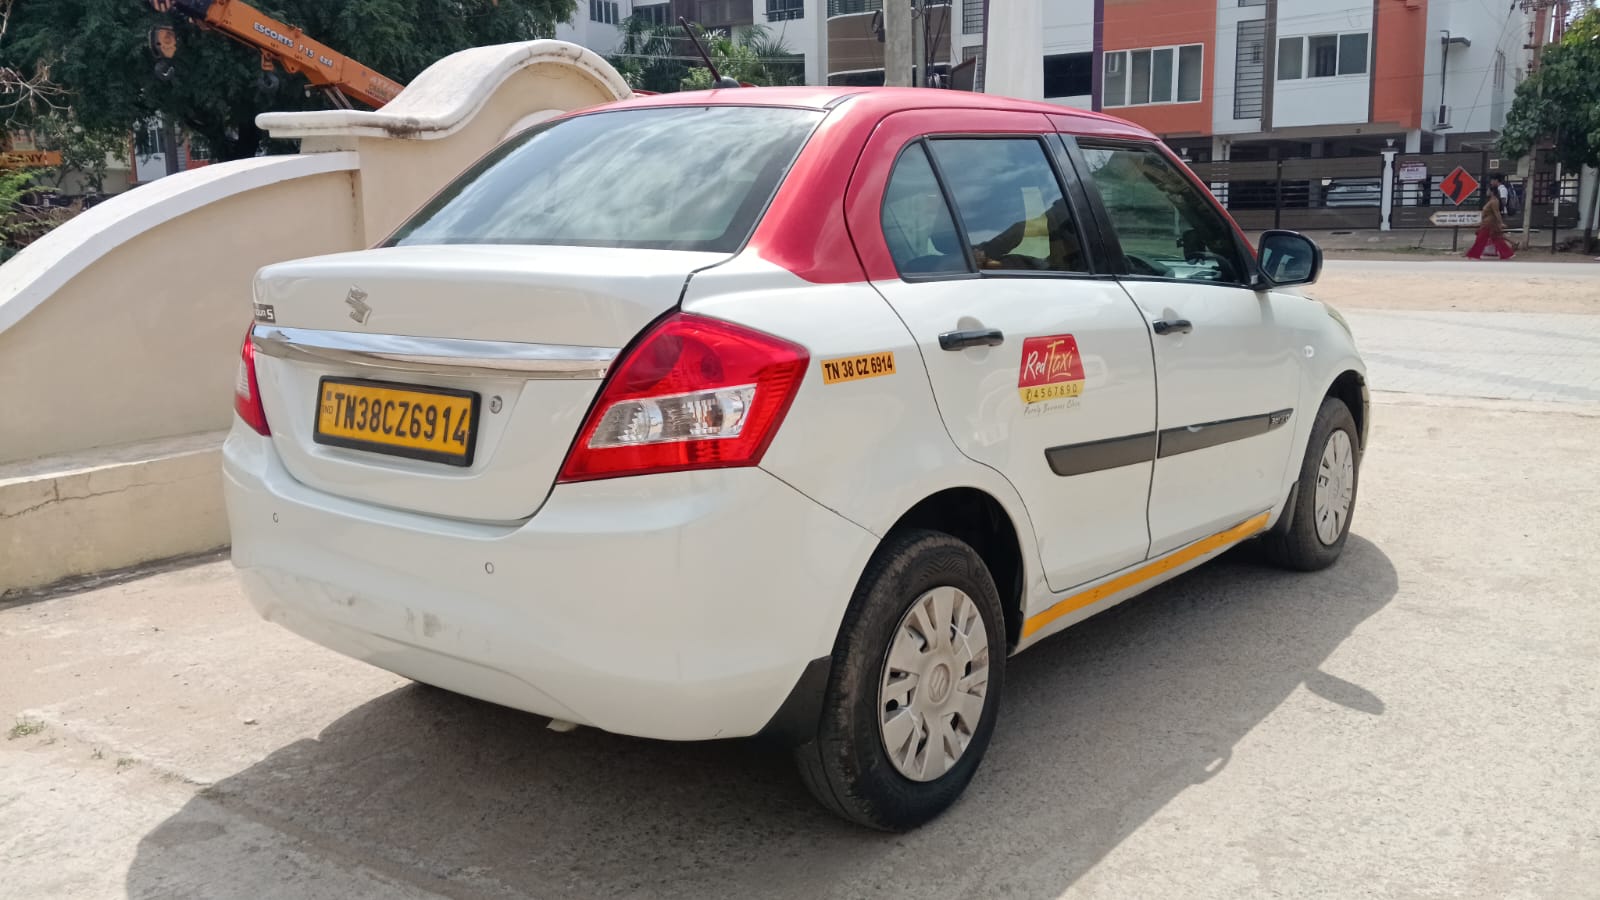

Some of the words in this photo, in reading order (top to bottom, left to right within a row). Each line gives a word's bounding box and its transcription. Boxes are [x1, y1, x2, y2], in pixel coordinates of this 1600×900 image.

[254, 22, 293, 47] ESCORTS
[267, 308, 274, 320] S
[825, 362, 840, 380] TN
[842, 360, 854, 377] 38
[856, 358, 869, 375] CZ
[871, 355, 893, 373] 6914
[1023, 350, 1049, 380] Red
[1047, 339, 1075, 382] Taxi
[334, 393, 468, 446] TN38CZ6914
